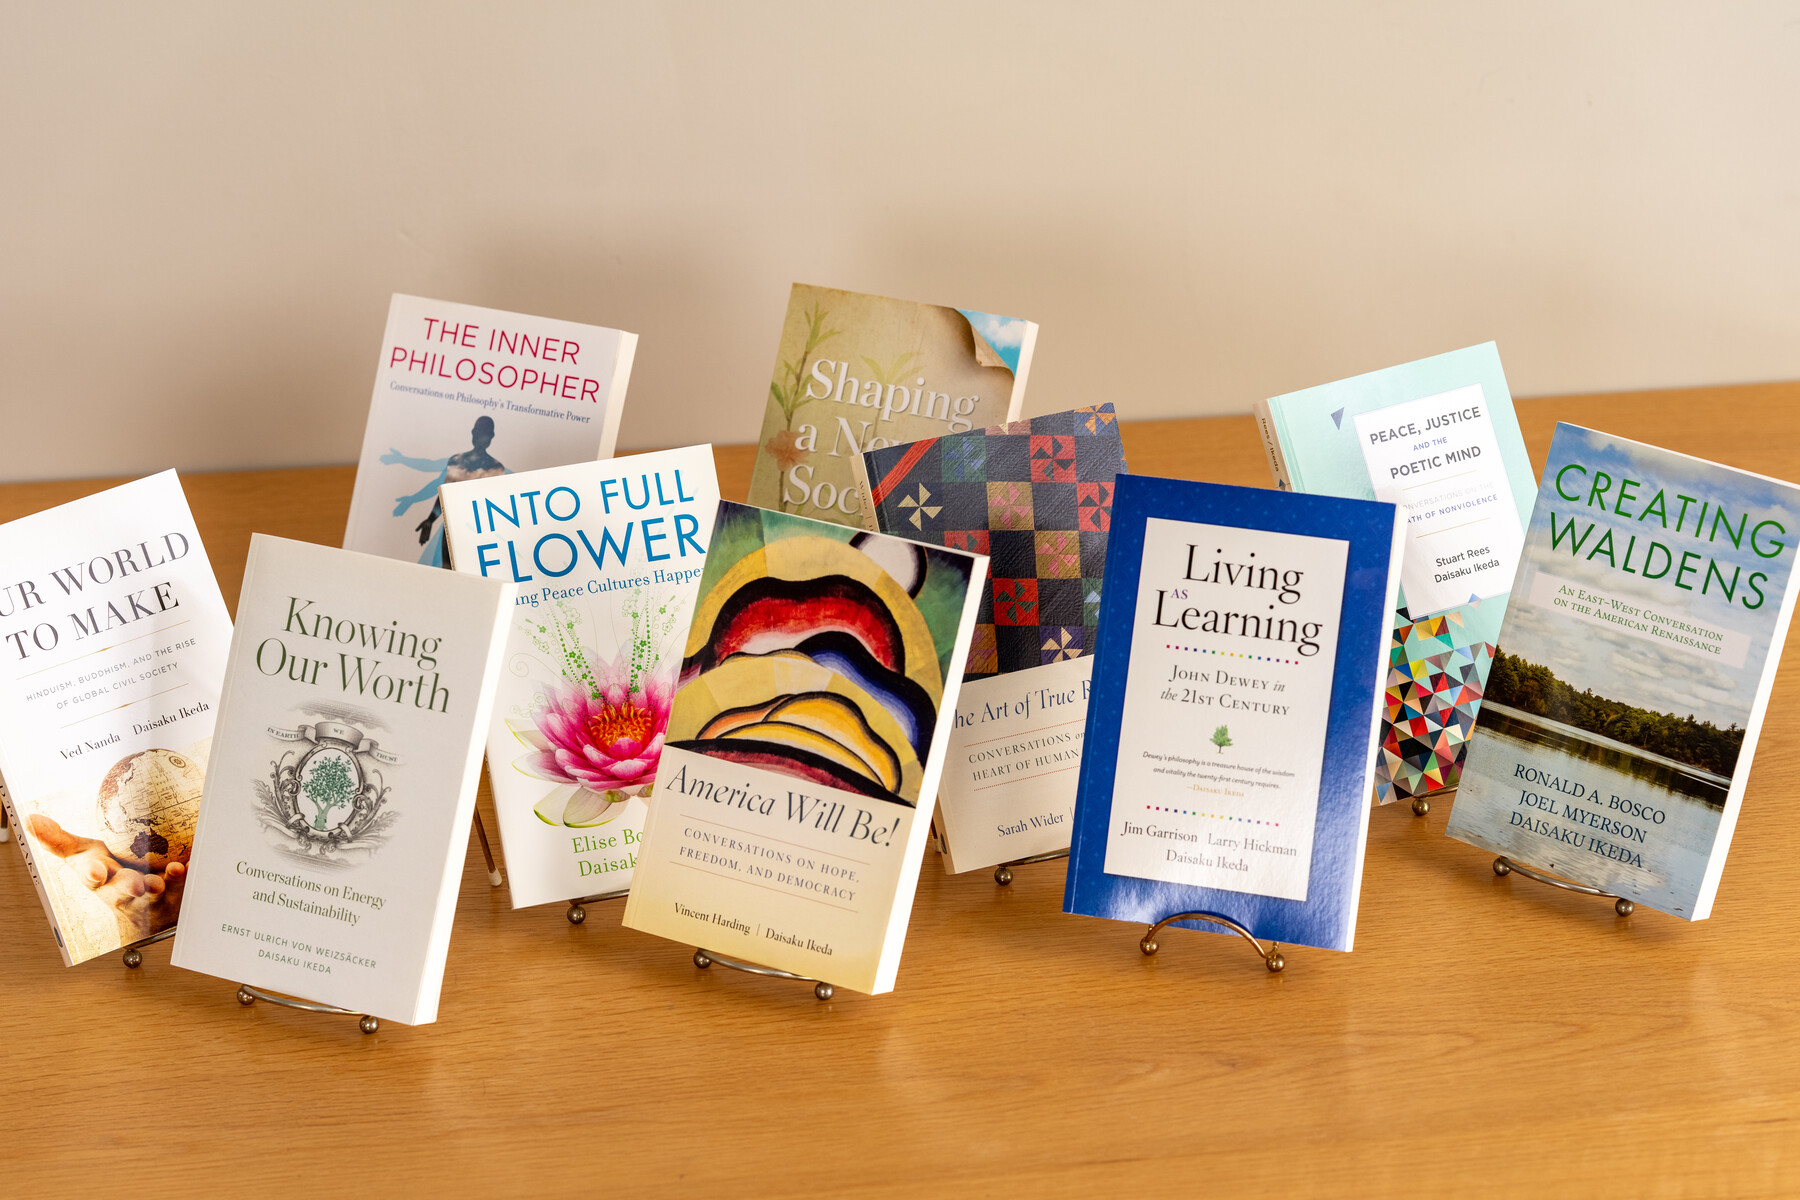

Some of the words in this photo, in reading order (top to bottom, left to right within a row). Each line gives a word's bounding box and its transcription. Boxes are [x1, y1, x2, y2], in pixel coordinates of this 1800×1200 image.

[423, 317, 480, 348] THE
[488, 328, 581, 366] INNER
[389, 346, 601, 403] PHILOSOPHER
[805, 357, 981, 434] Shaping
[389, 380, 444, 399] Conversations
[444, 392, 455, 401] on
[506, 399, 566, 420] Transformative
[565, 410, 592, 424] Power
[1369, 422, 1421, 445] PEACE,
[1425, 406, 1482, 431] JUSTICE
[794, 423, 818, 453] a
[1261, 417, 1270, 440] Rees
[1269, 447, 1279, 472] Ikeda
[1413, 441, 1430, 452] AND
[1432, 436, 1448, 447] THE
[1389, 456, 1442, 479] POETIC
[1445, 445, 1482, 465] MIND
[471, 485, 581, 534] INTO
[600, 469, 695, 515] FULL
[1424, 510, 1436, 519] OF
[1438, 493, 1498, 516] NONVIOLENCE
[1555, 463, 1787, 559] CREATING
[48, 532, 190, 596] WORLD
[476, 512, 707, 584] FLOWER
[1434, 567, 1472, 583] Daisaku
[1473, 558, 1500, 572] Ikeda
[1435, 552, 1465, 567] Stuart
[1466, 546, 1491, 559] Rees
[1550, 511, 1769, 610] WALDENS
[541, 585, 584, 602] Peace
[587, 575, 650, 594] Cultures
[652, 567, 704, 586] Happe
[1170, 588, 1189, 600] AS
[1182, 543, 1305, 605] Living
[5, 623, 59, 661] TO
[67, 581, 180, 641] MAKE
[281, 595, 443, 671] Knowing
[1151, 589, 1324, 657] Learning
[1553, 597, 1569, 608] ON
[1571, 601, 1592, 615] THE
[1593, 608, 1649, 632] AMERICAN
[1651, 625, 1722, 655] RENAISSANCE
[1643, 609, 1724, 642] CONVERSATION
[26, 679, 76, 702] HINDUISM,
[78, 662, 130, 684] BUDDHISM,
[132, 653, 153, 666] AND
[154, 646, 173, 658] THE
[175, 638, 197, 651] RISE
[56, 700, 68, 710] OF
[72, 686, 110, 705] GLOBAL
[112, 677, 137, 691] CIVIL
[139, 661, 179, 682] SOCIETY
[256, 637, 329, 686] Our
[337, 652, 450, 714] Worth
[1168, 664, 1211, 683] JOHN
[1215, 670, 1271, 691] DEWEY
[1272, 680, 1286, 692] in
[981, 701, 1009, 723] Art
[1014, 691, 1032, 720] of
[1034, 687, 1076, 710] True
[1160, 687, 1178, 701] the
[1218, 693, 1291, 717] CENTURY
[59, 744, 83, 761] Ved
[84, 732, 121, 753] Nanda
[132, 712, 178, 736] Daisaku
[178, 701, 210, 720] Ikeda
[275, 730, 299, 739] EARTH
[333, 727, 345, 735] WE
[968, 731, 1072, 764] CONVERSATIONS
[972, 763, 1012, 782] HEART
[1015, 759, 1033, 772] OF
[1035, 748, 1080, 768] HUMAN
[1153, 766, 1166, 774] and
[1165, 768, 1187, 778] vitality
[1186, 770, 1197, 778] the
[1197, 772, 1231, 783] twenty-first
[1231, 777, 1255, 787] century
[1167, 755, 1201, 766] philosophy
[1211, 761, 1236, 770] treasure
[1236, 763, 1254, 772] house
[1254, 766, 1262, 775] of
[1262, 767, 1272, 775] the
[1271, 770, 1296, 778] wisdom
[665, 763, 776, 818] America
[785, 790, 847, 834] Will
[849, 808, 901, 847] Be!
[1513, 763, 1586, 798] RONALD
[1587, 789, 1603, 806] A.
[1607, 794, 1667, 825] BOSCO
[1517, 789, 1560, 815] JOEL
[1561, 804, 1648, 844] MYERSON
[571, 835, 618, 854] Elise
[997, 819, 1028, 838] Sarah
[1029, 812, 1065, 829] Wider
[1120, 821, 1144, 837] Jim
[1146, 824, 1199, 843] Garrison
[1207, 832, 1242, 851] Larry
[1243, 837, 1298, 857] Hickman
[1510, 811, 1585, 848] DAISAKU
[1587, 837, 1643, 868] IKEDA
[679, 845, 743, 873] FREEDOM,
[746, 864, 774, 880] AND
[776, 871, 858, 902] DEMOCRACY
[684, 826, 793, 865] CONVERSATIONS
[796, 857, 817, 871] ON
[820, 863, 861, 884] HOPE,
[1166, 848, 1214, 868] Daisaku
[1216, 855, 1250, 873] Ikeda
[236, 860, 322, 893] Conversations
[323, 884, 340, 898] on
[342, 885, 388, 911] Energy
[252, 890, 276, 905] and
[276, 892, 361, 927] Sustainability
[221, 923, 251, 938] ERNST
[254, 931, 289, 948] ULRICH
[291, 941, 312, 953] VON
[315, 946, 377, 969] WEIZSÄCKER
[674, 902, 710, 923] Vincent
[711, 913, 751, 936] Harding
[765, 927, 805, 949] Daisaku
[806, 938, 834, 957] Ikeda
[257, 949, 300, 967] DAISAKU
[302, 960, 332, 975] IKEDA
